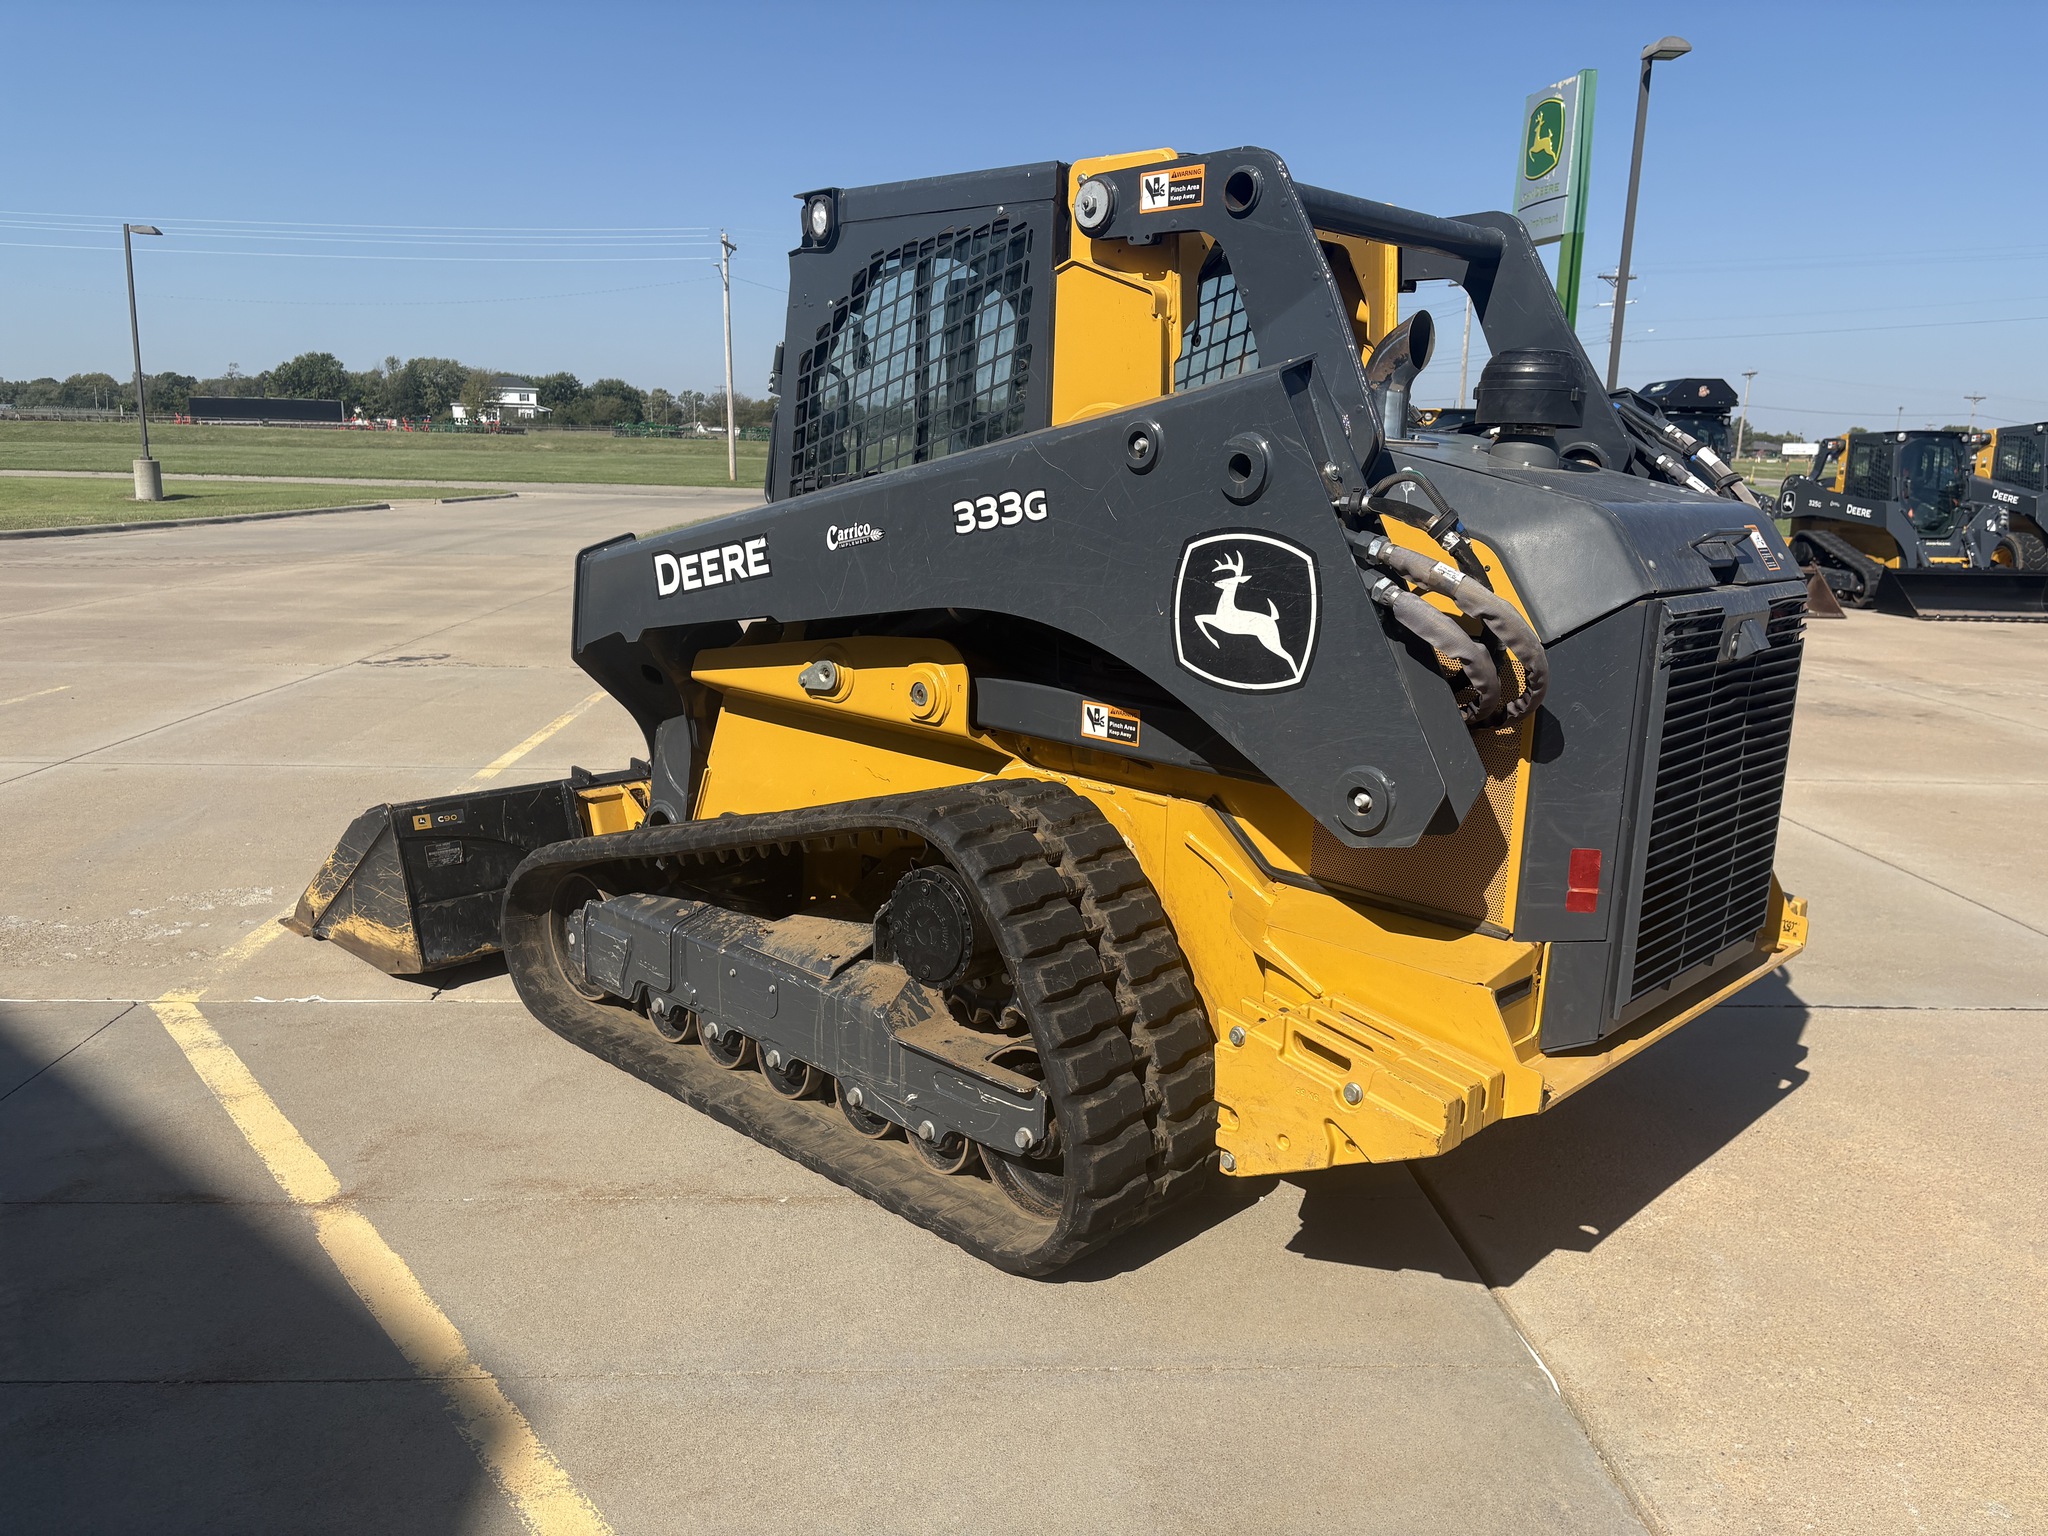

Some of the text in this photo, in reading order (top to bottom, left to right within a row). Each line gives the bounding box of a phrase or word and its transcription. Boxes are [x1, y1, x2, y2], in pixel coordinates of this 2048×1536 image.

[1177, 168, 1202, 177] WARNING
[1170, 185, 1186, 193] Pinch
[1991, 489, 2020, 505] DEERE
[953, 490, 1048, 534] 333G
[1846, 503, 1873, 519] DEERE
[826, 522, 871, 551] Carrico
[839, 537, 870, 548] IMPLEMENT
[653, 537, 770, 597] DEERE
[1109, 721, 1136, 732] Pinch Area
[1109, 729, 1132, 739] Keep Away
[437, 814, 458, 823] C90
